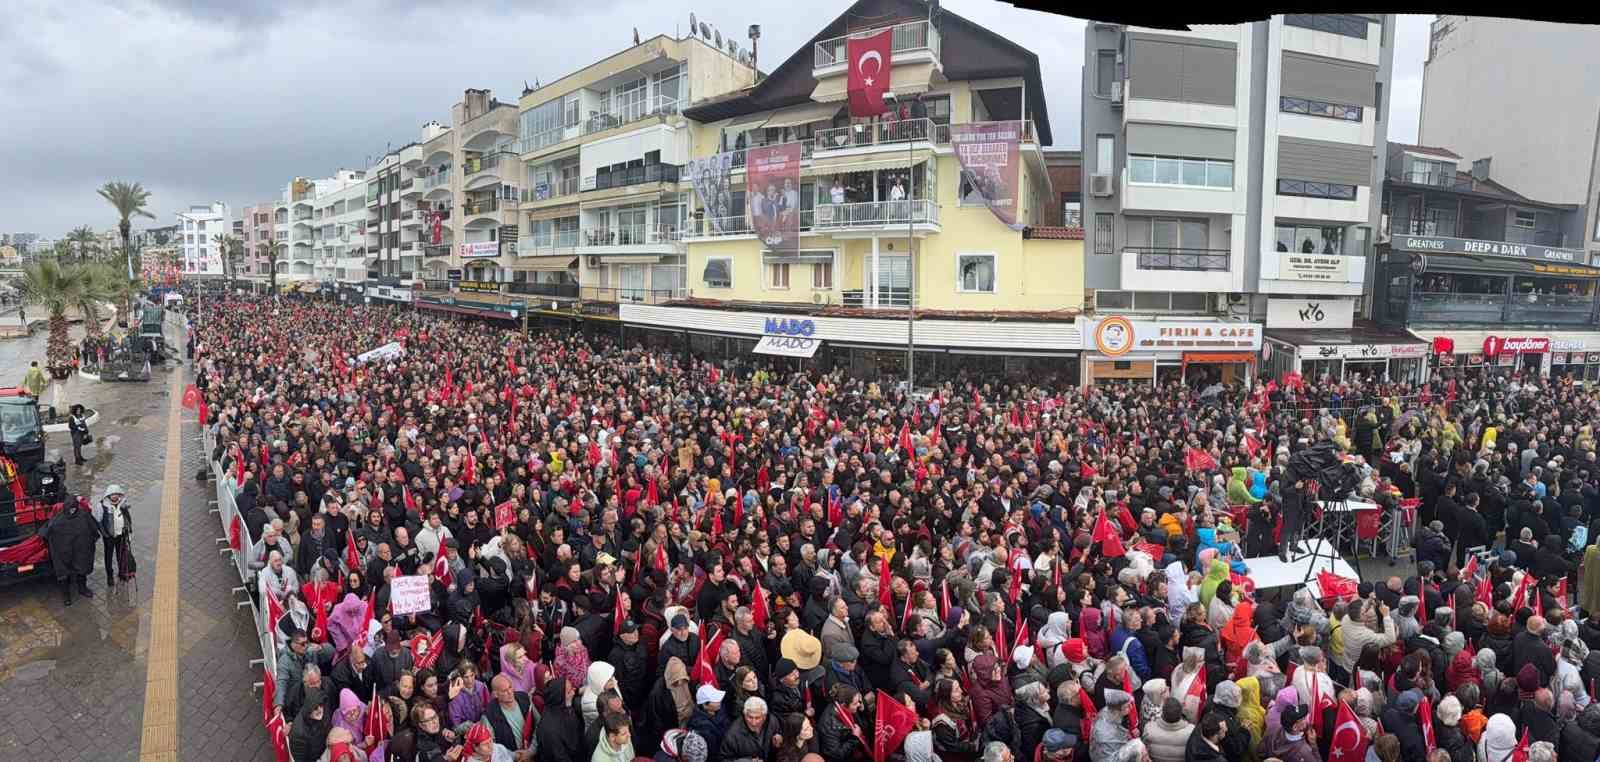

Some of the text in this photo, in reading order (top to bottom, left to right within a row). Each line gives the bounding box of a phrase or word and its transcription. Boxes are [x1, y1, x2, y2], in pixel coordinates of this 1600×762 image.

[1407, 238, 1444, 250] GREATNESS
[1464, 241, 1491, 253] DEEP
[1501, 244, 1527, 257] DARK
[1544, 249, 1574, 260] GREATNESS
[1298, 302, 1325, 322] KYO
[765, 317, 816, 337] MADO
[1160, 327, 1199, 337] FIRIN
[1219, 328, 1255, 338] CAFE
[767, 338, 814, 350] MADO
[1503, 337, 1549, 353] baydöner
